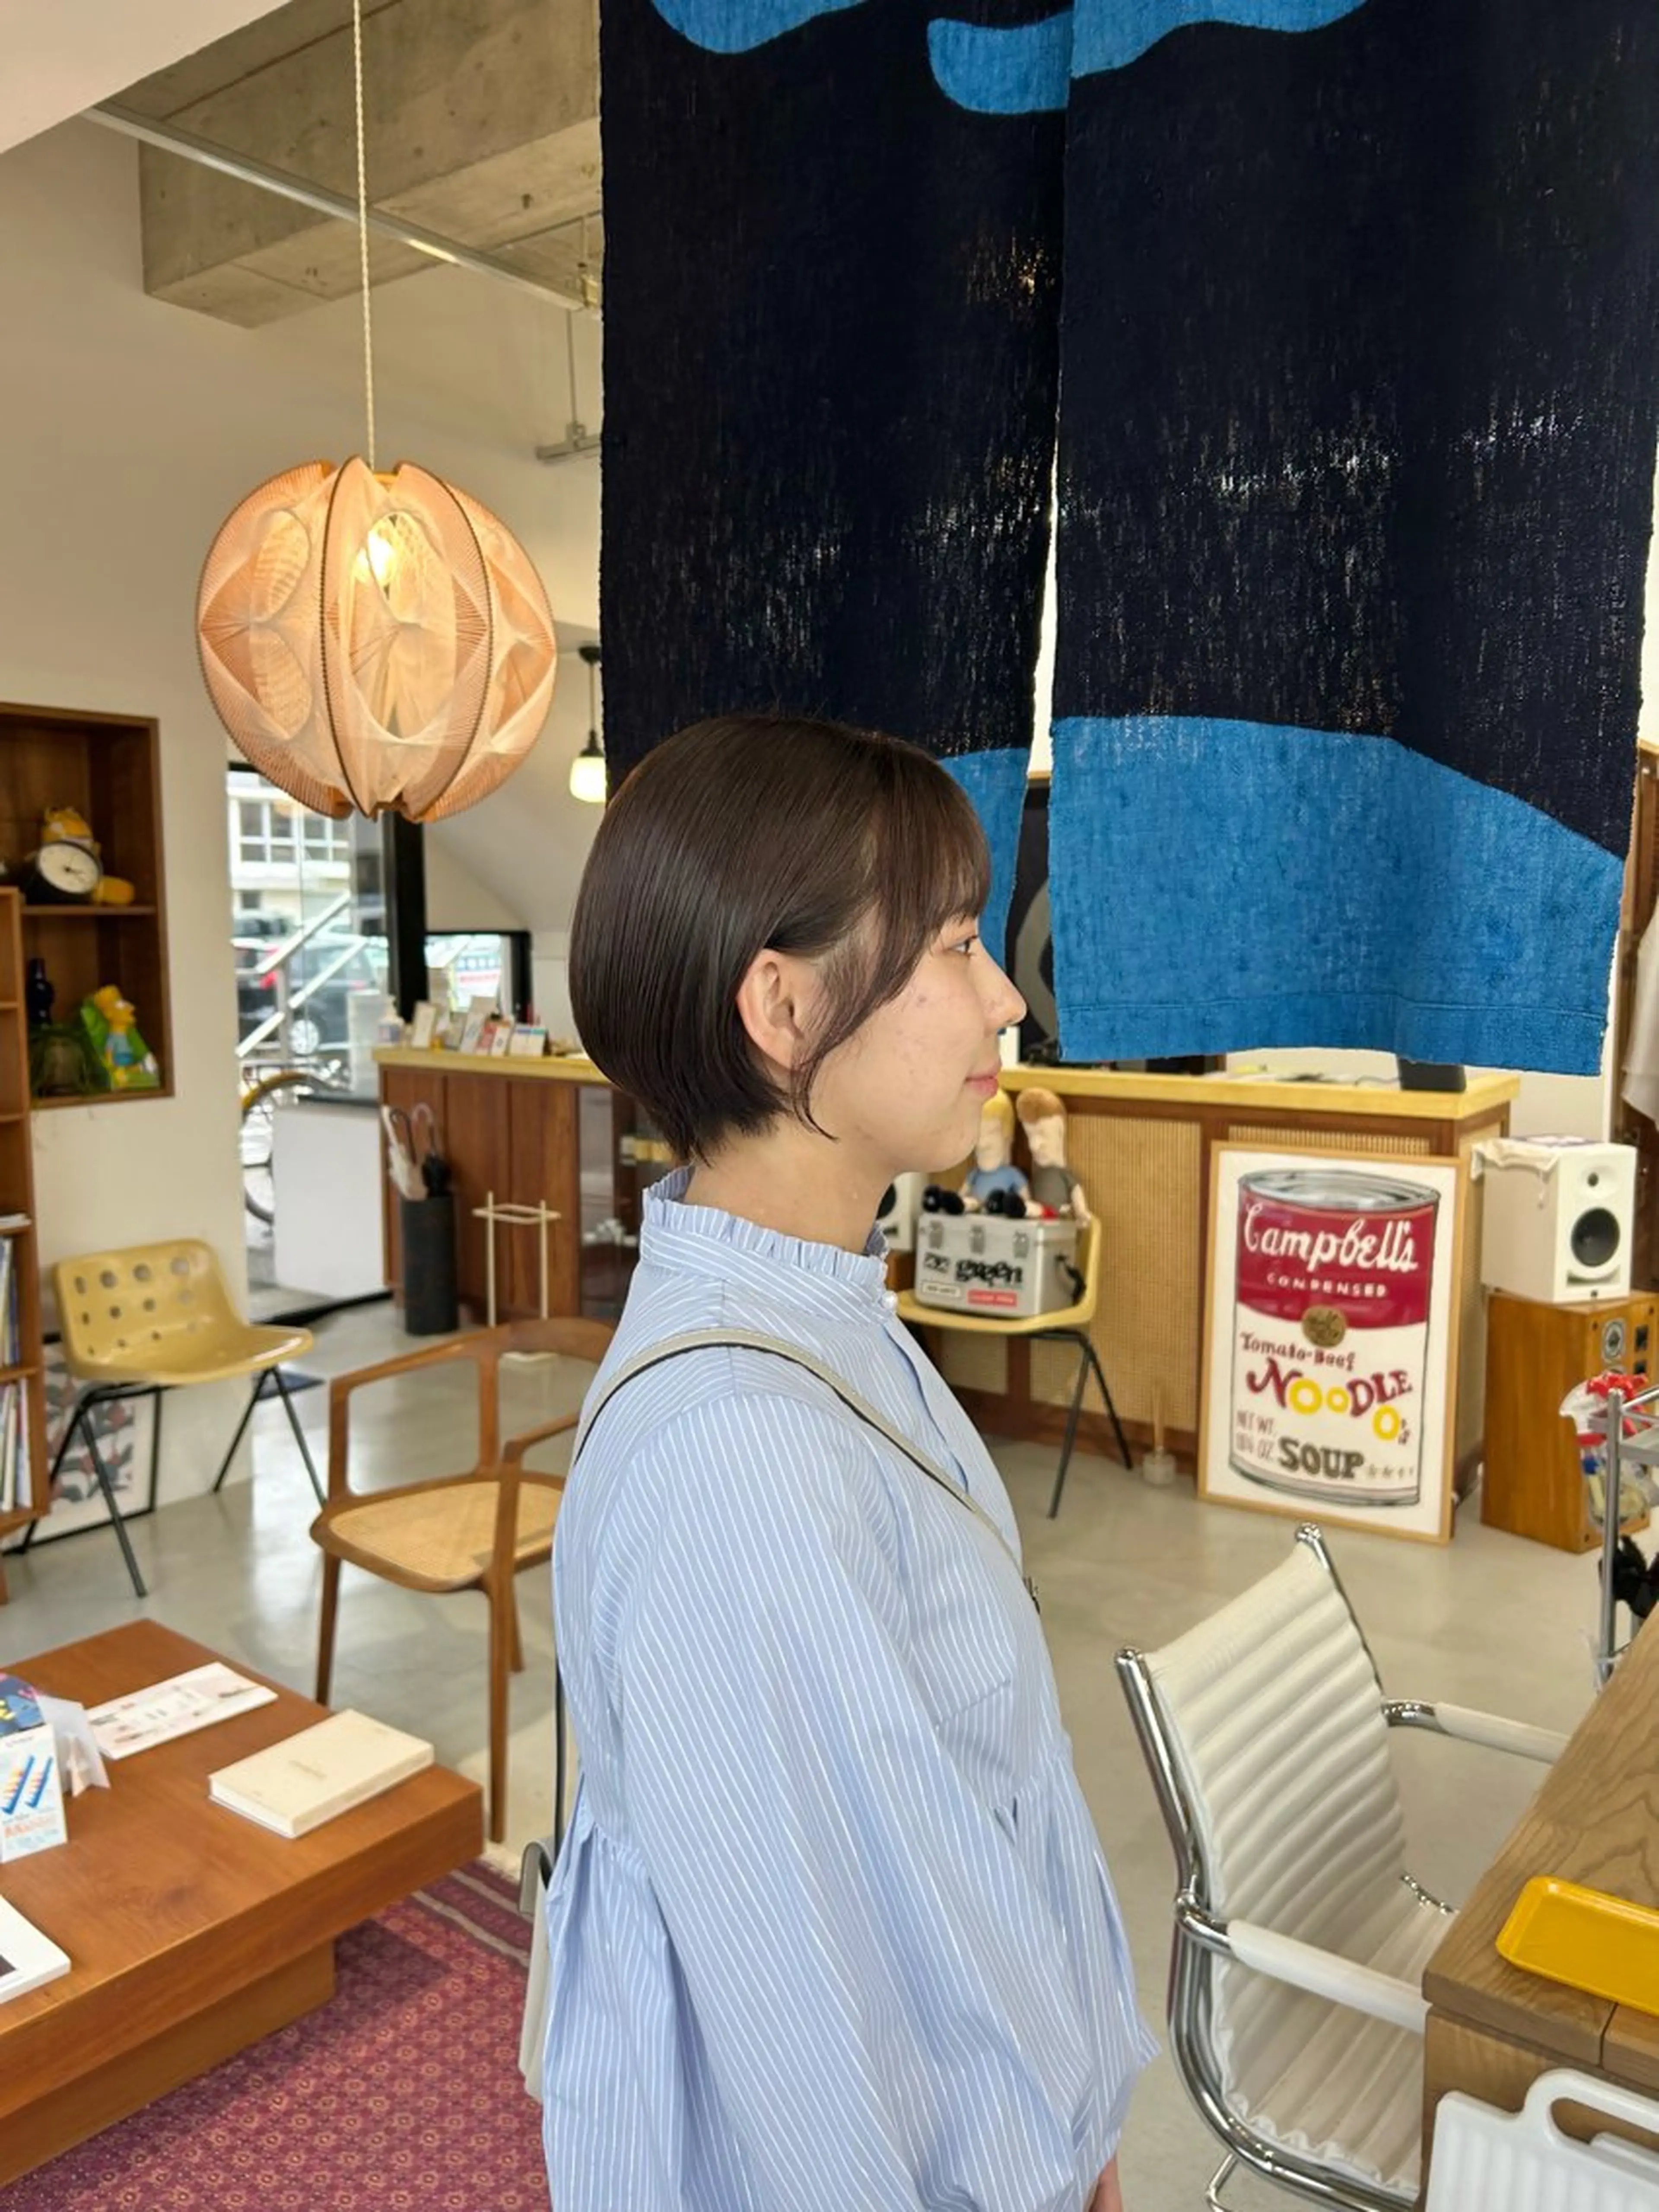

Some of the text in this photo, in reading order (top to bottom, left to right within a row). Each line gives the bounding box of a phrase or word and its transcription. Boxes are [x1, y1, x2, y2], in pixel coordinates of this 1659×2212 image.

[1243, 1202, 1418, 1273] Campbell's
[1267, 1272, 1387, 1297] CONDENSED
[1240, 1332, 1356, 1371] Tomato-Beef
[1278, 1436, 1365, 1479] SOUP
